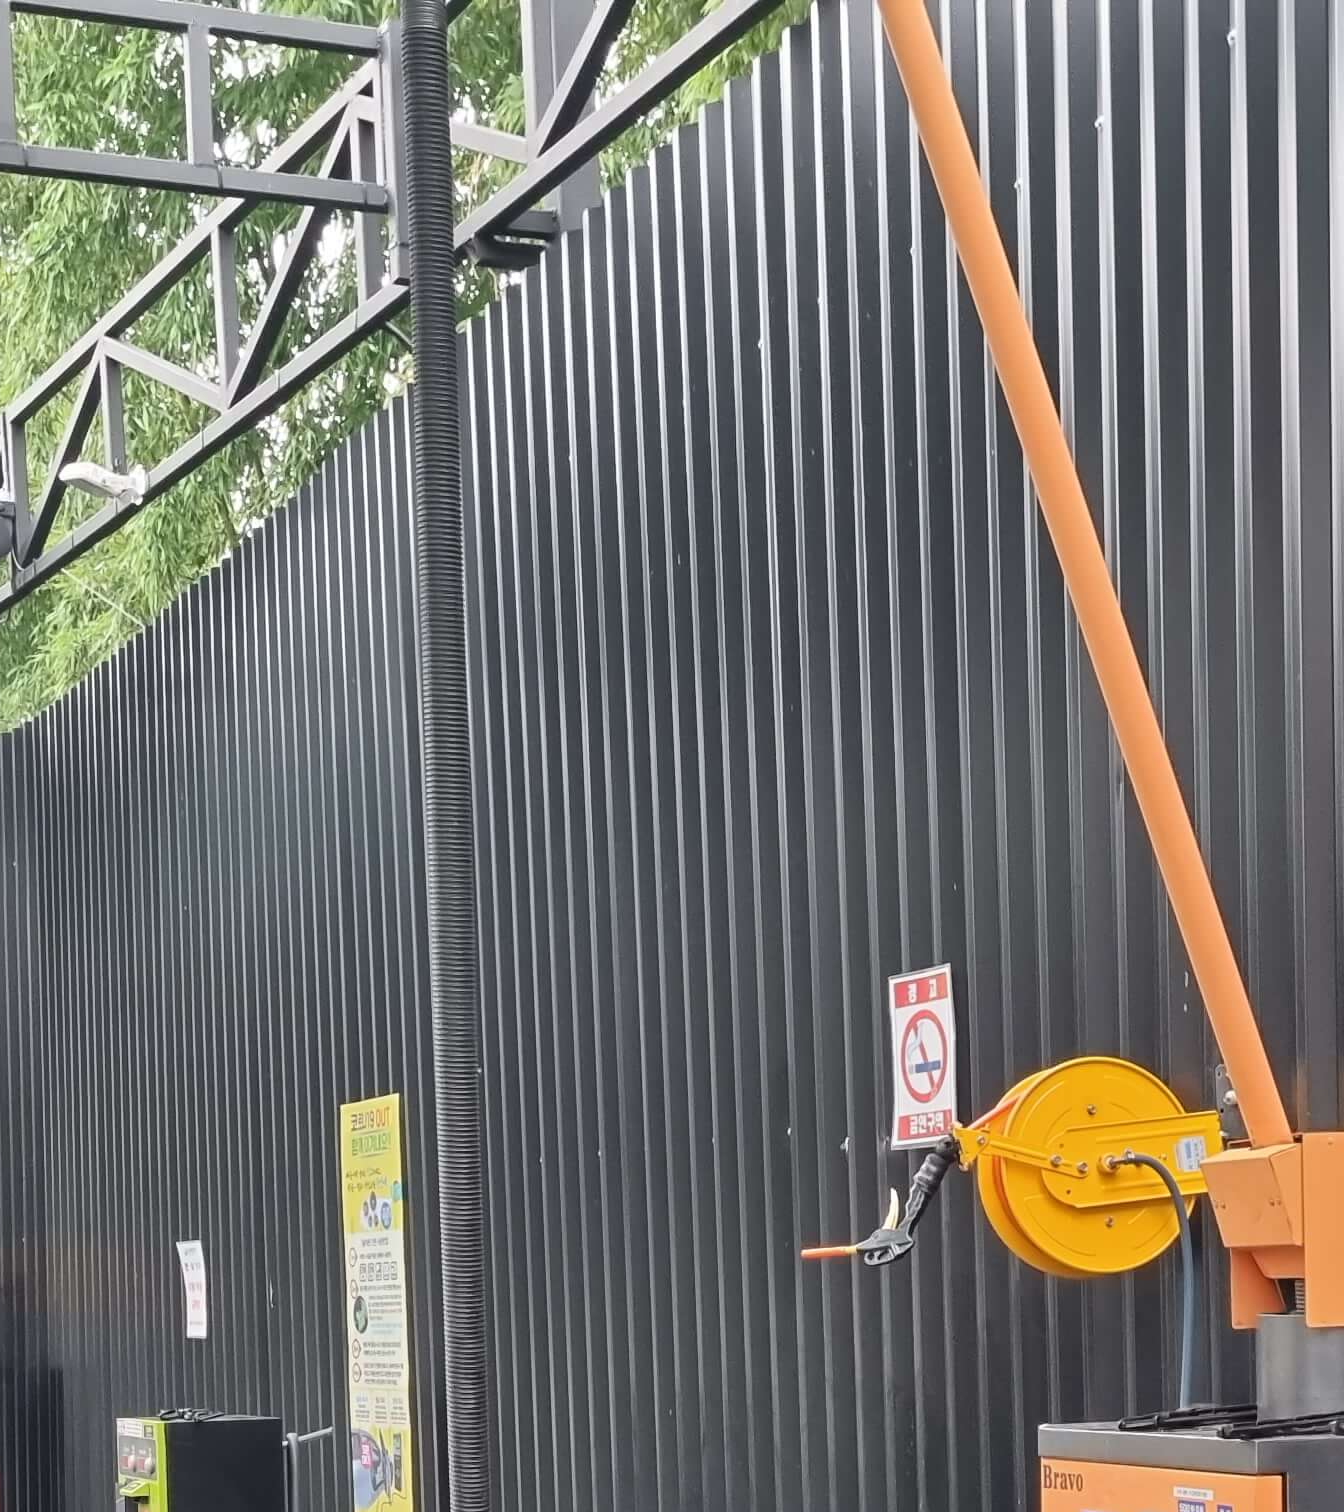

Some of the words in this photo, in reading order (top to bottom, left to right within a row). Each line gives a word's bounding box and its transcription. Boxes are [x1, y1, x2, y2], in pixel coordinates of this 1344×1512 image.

[376, 1106, 391, 1128] OUT
[909, 1111, 945, 1136] 금연구역
[1043, 1464, 1084, 1492] Bravo
